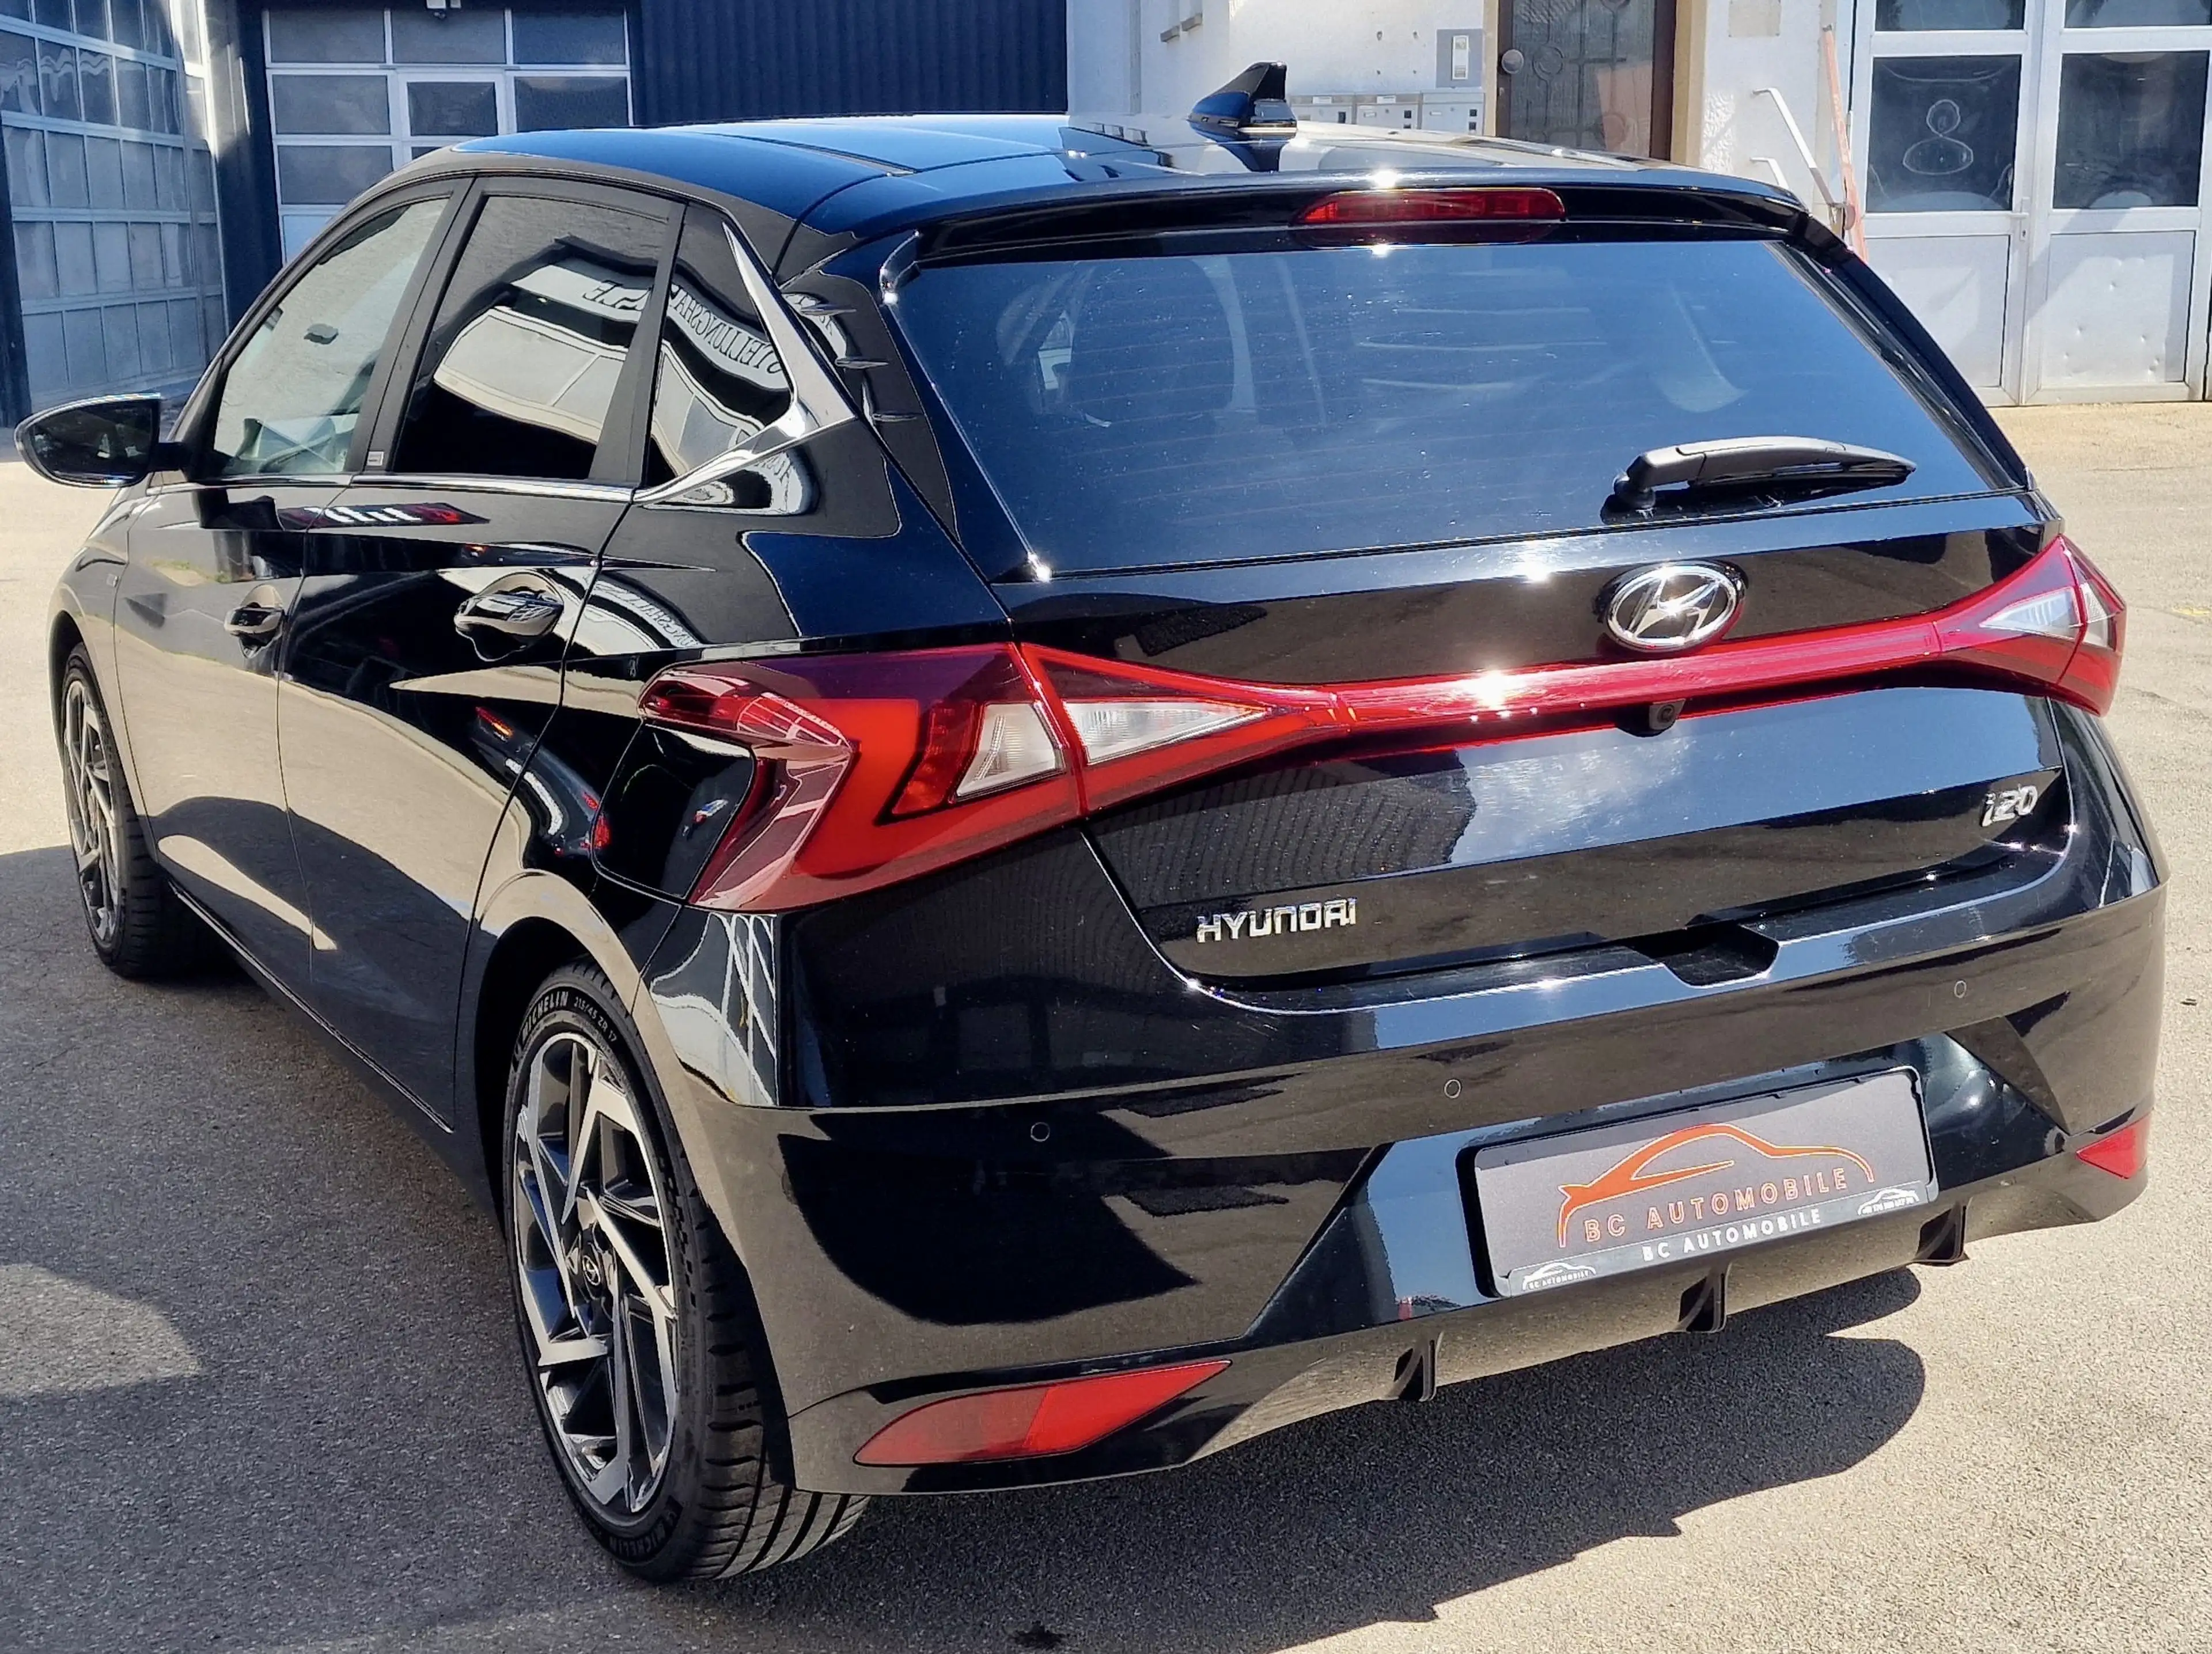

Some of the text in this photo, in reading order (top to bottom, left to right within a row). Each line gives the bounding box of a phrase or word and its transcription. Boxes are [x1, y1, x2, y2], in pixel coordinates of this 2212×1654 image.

[1981, 784, 2039, 827] i20
[1196, 896, 1358, 943] HYUNDAI
[522, 991, 569, 1042] MICHELIN
[574, 996, 597, 1019] 215/45
[608, 1030, 618, 1042] 17
[1584, 1213, 1626, 1243] BC
[1646, 1167, 1848, 1230] AUTOMOBILE
[1642, 1208, 1821, 1262] BC AUTOMOBILE
